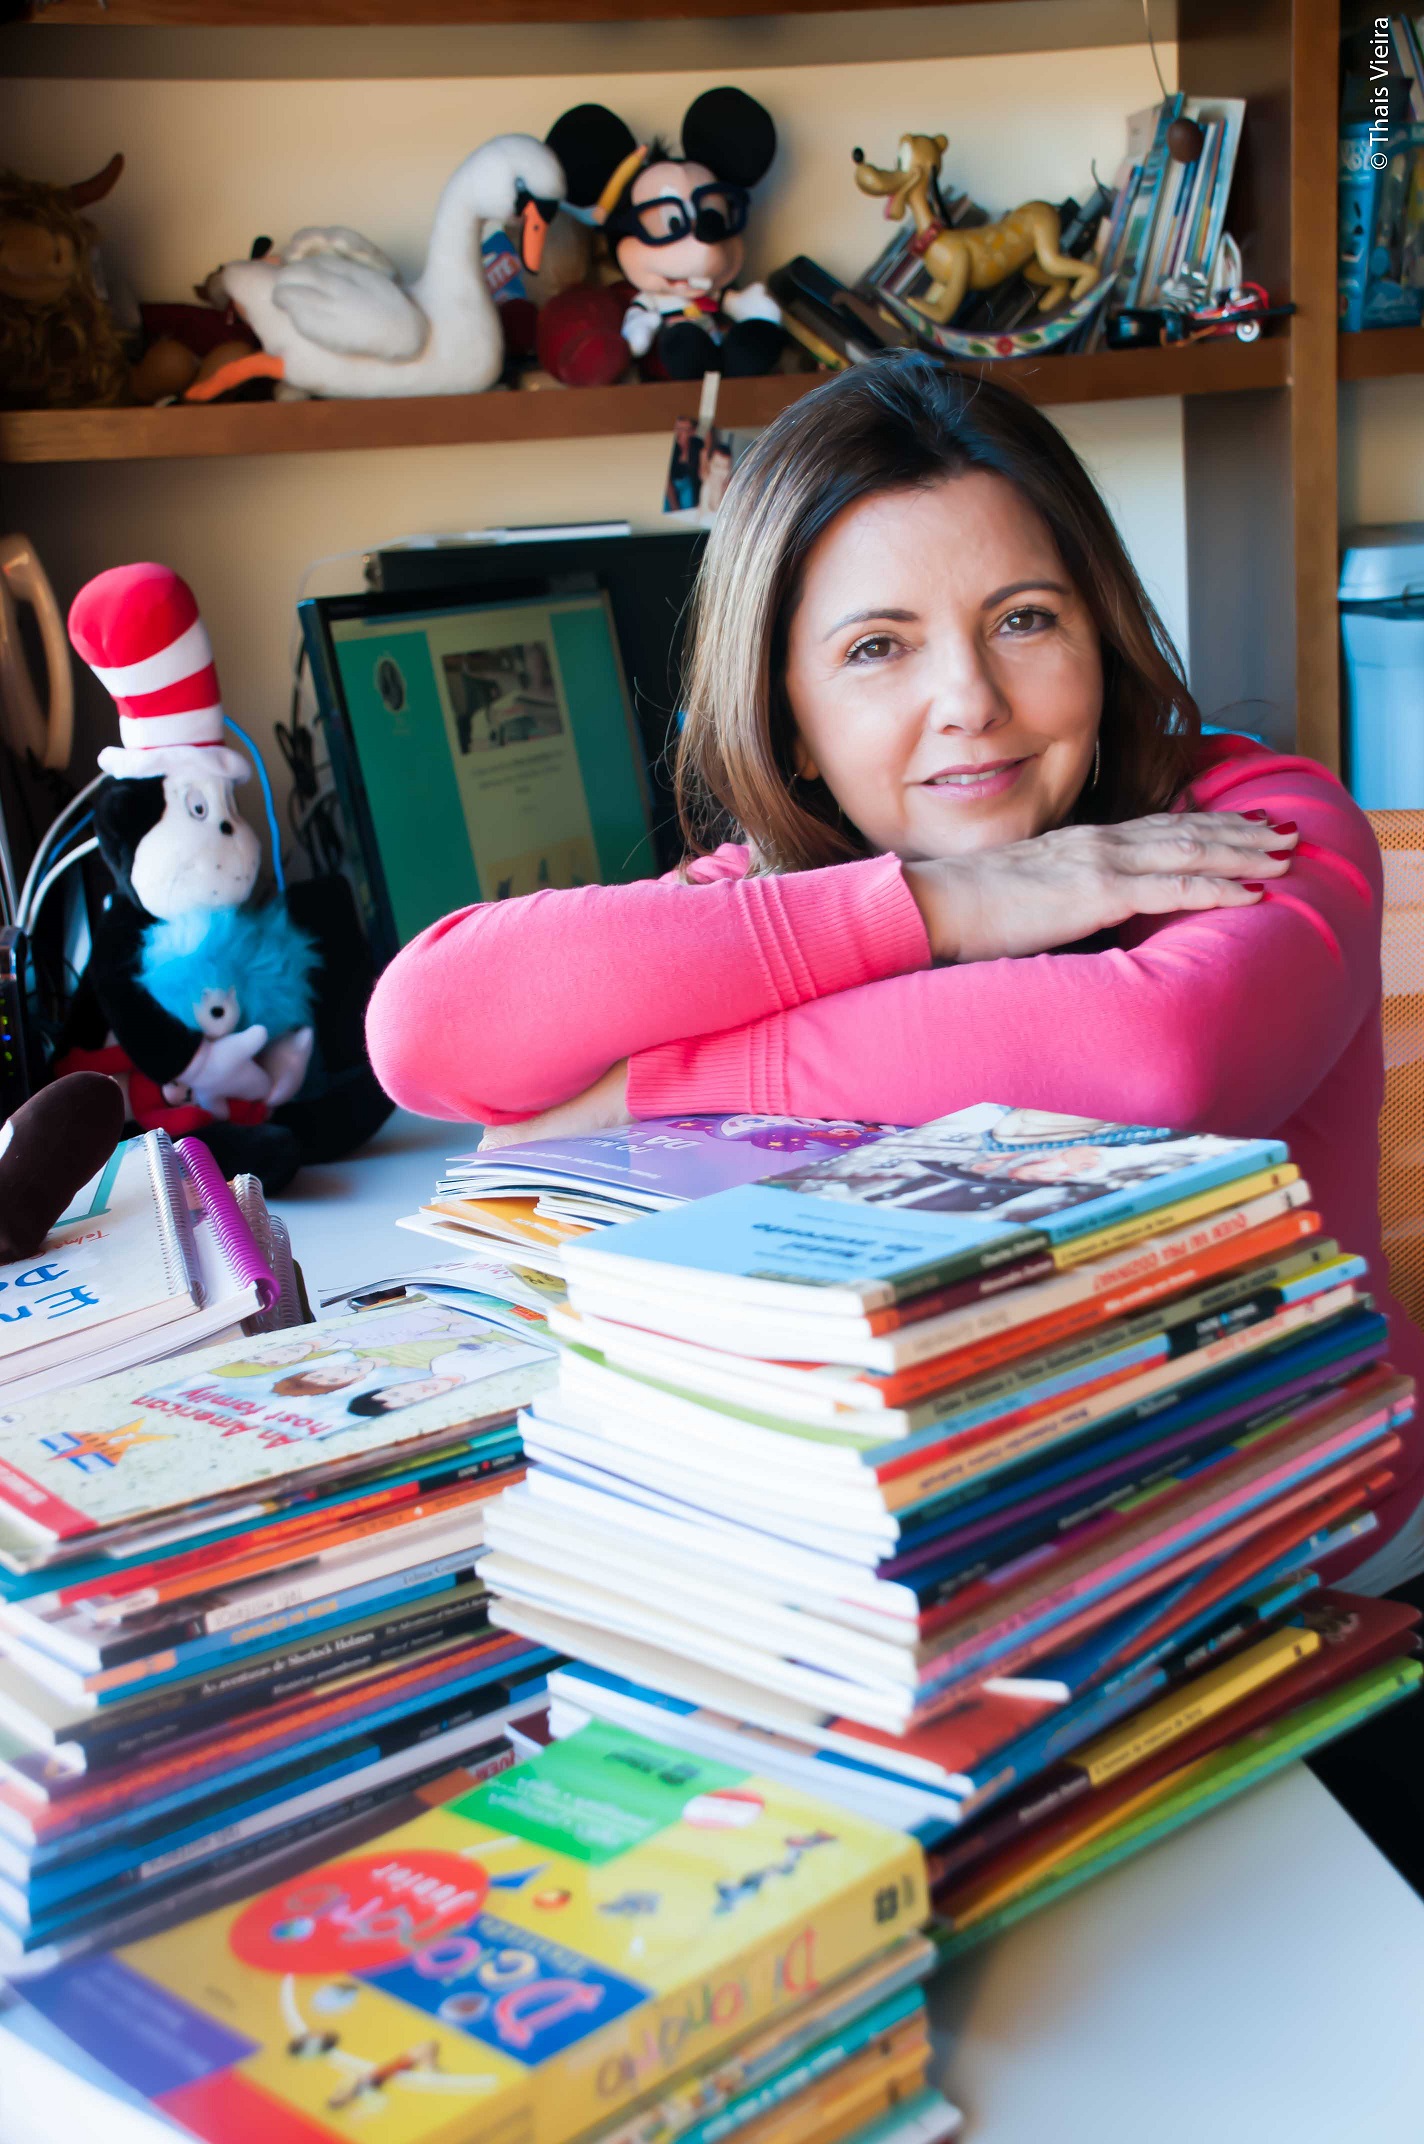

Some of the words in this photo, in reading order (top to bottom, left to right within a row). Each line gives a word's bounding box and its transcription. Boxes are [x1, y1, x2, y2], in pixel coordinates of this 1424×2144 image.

[177, 1384, 268, 1416] family
[130, 1395, 260, 1437] American
[263, 1410, 334, 1436] host
[257, 1428, 303, 1449] An
